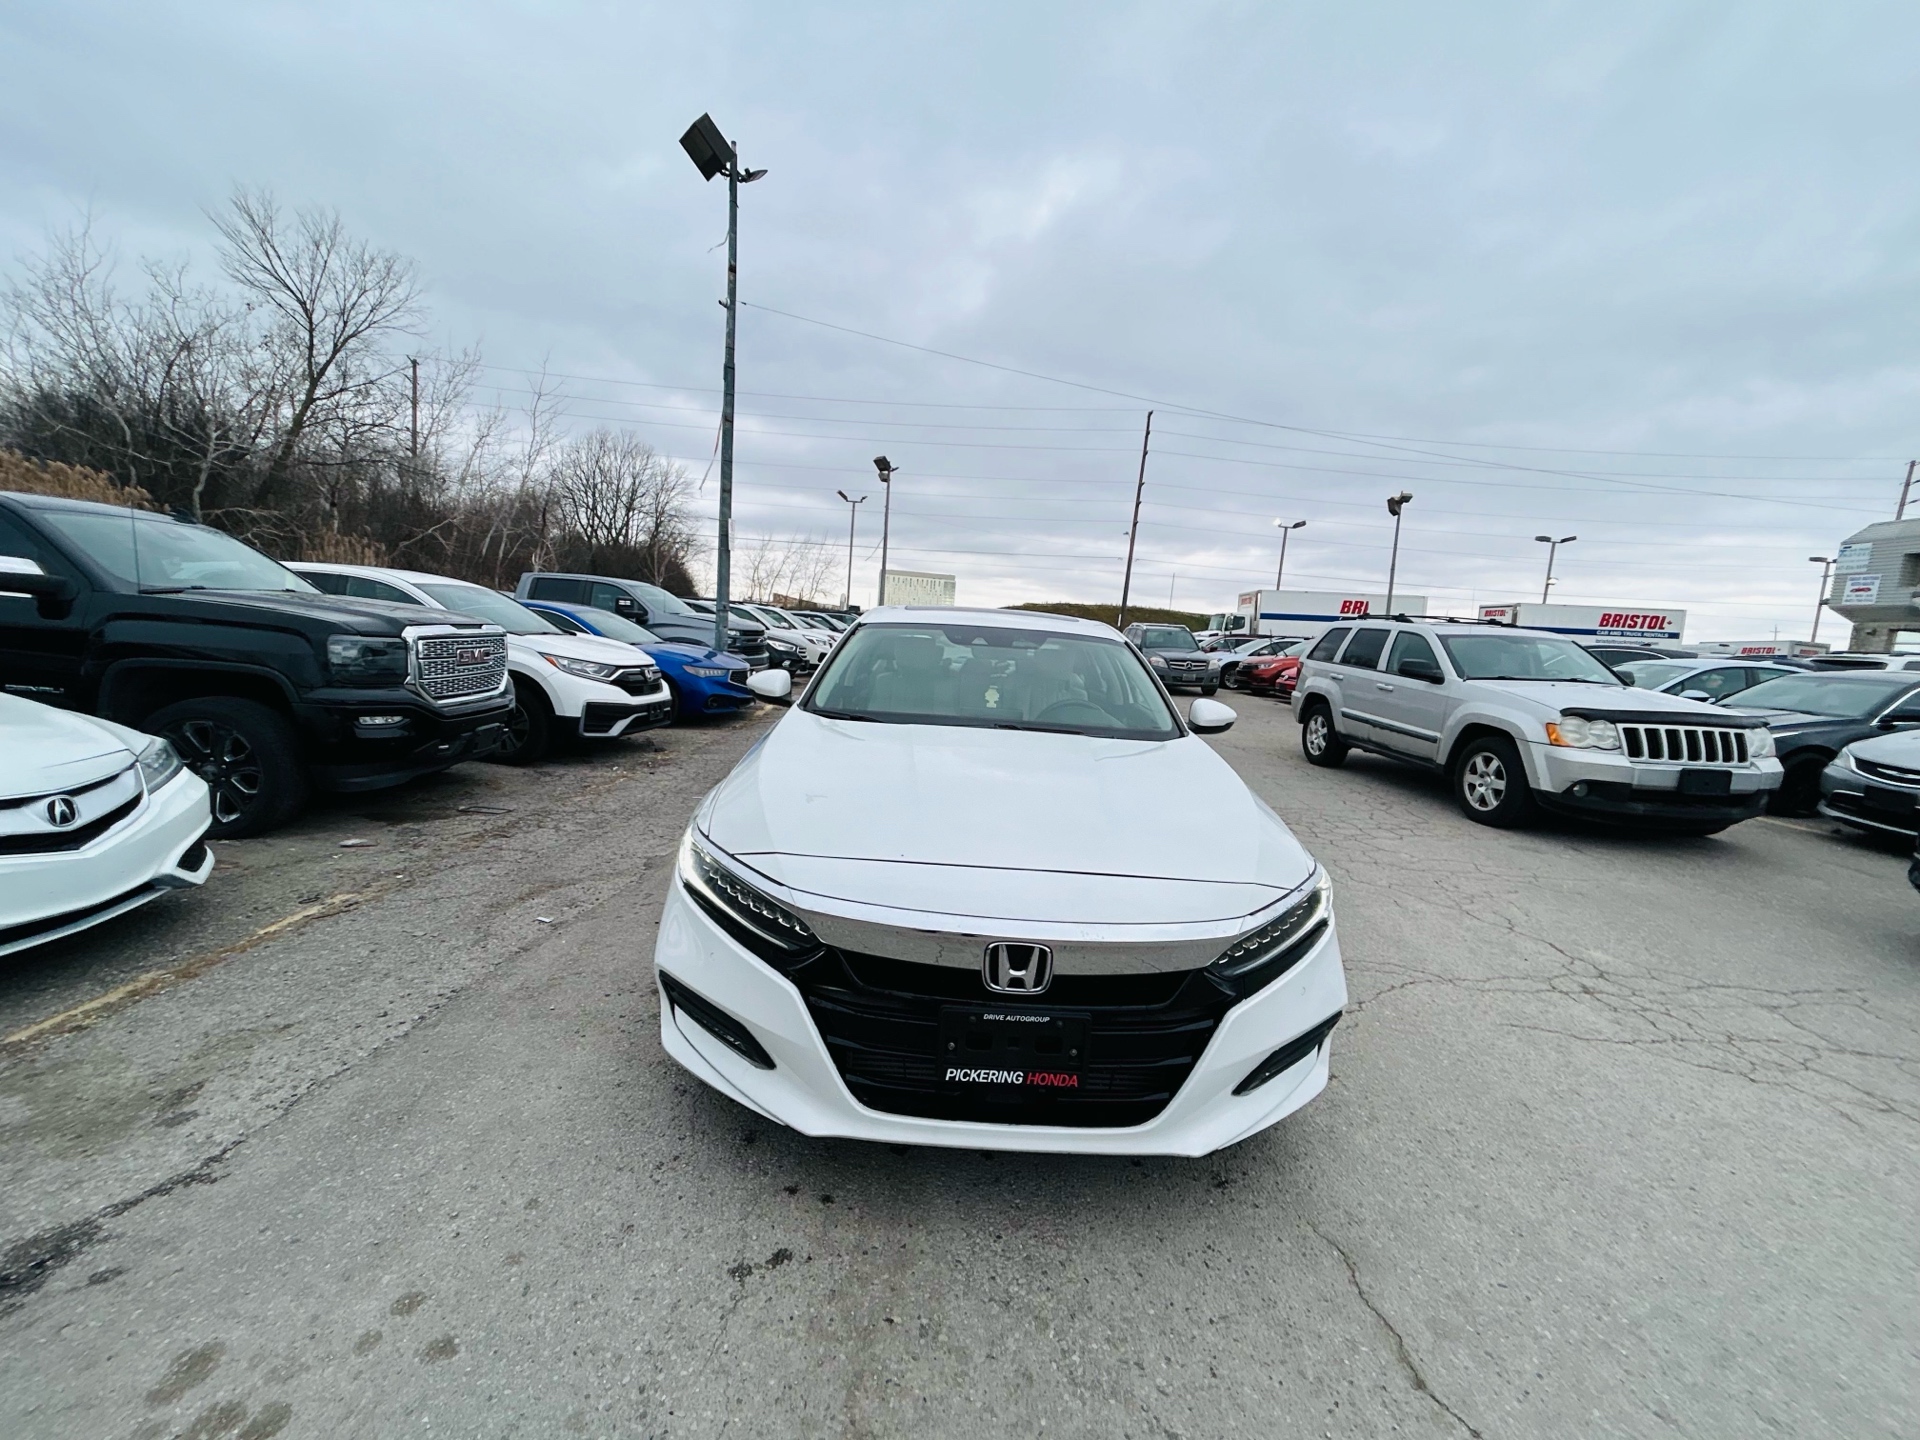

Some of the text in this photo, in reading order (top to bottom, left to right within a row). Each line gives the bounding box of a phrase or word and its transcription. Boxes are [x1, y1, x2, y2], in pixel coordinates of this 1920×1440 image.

[1598, 613, 1667, 630] BRISTOL
[457, 648, 491, 664] GMC
[1741, 647, 1776, 655] BRISTOL
[983, 1013, 1050, 1023] DRIVE AUTOGROUP
[945, 1068, 1079, 1087] PICKERING HONDA
